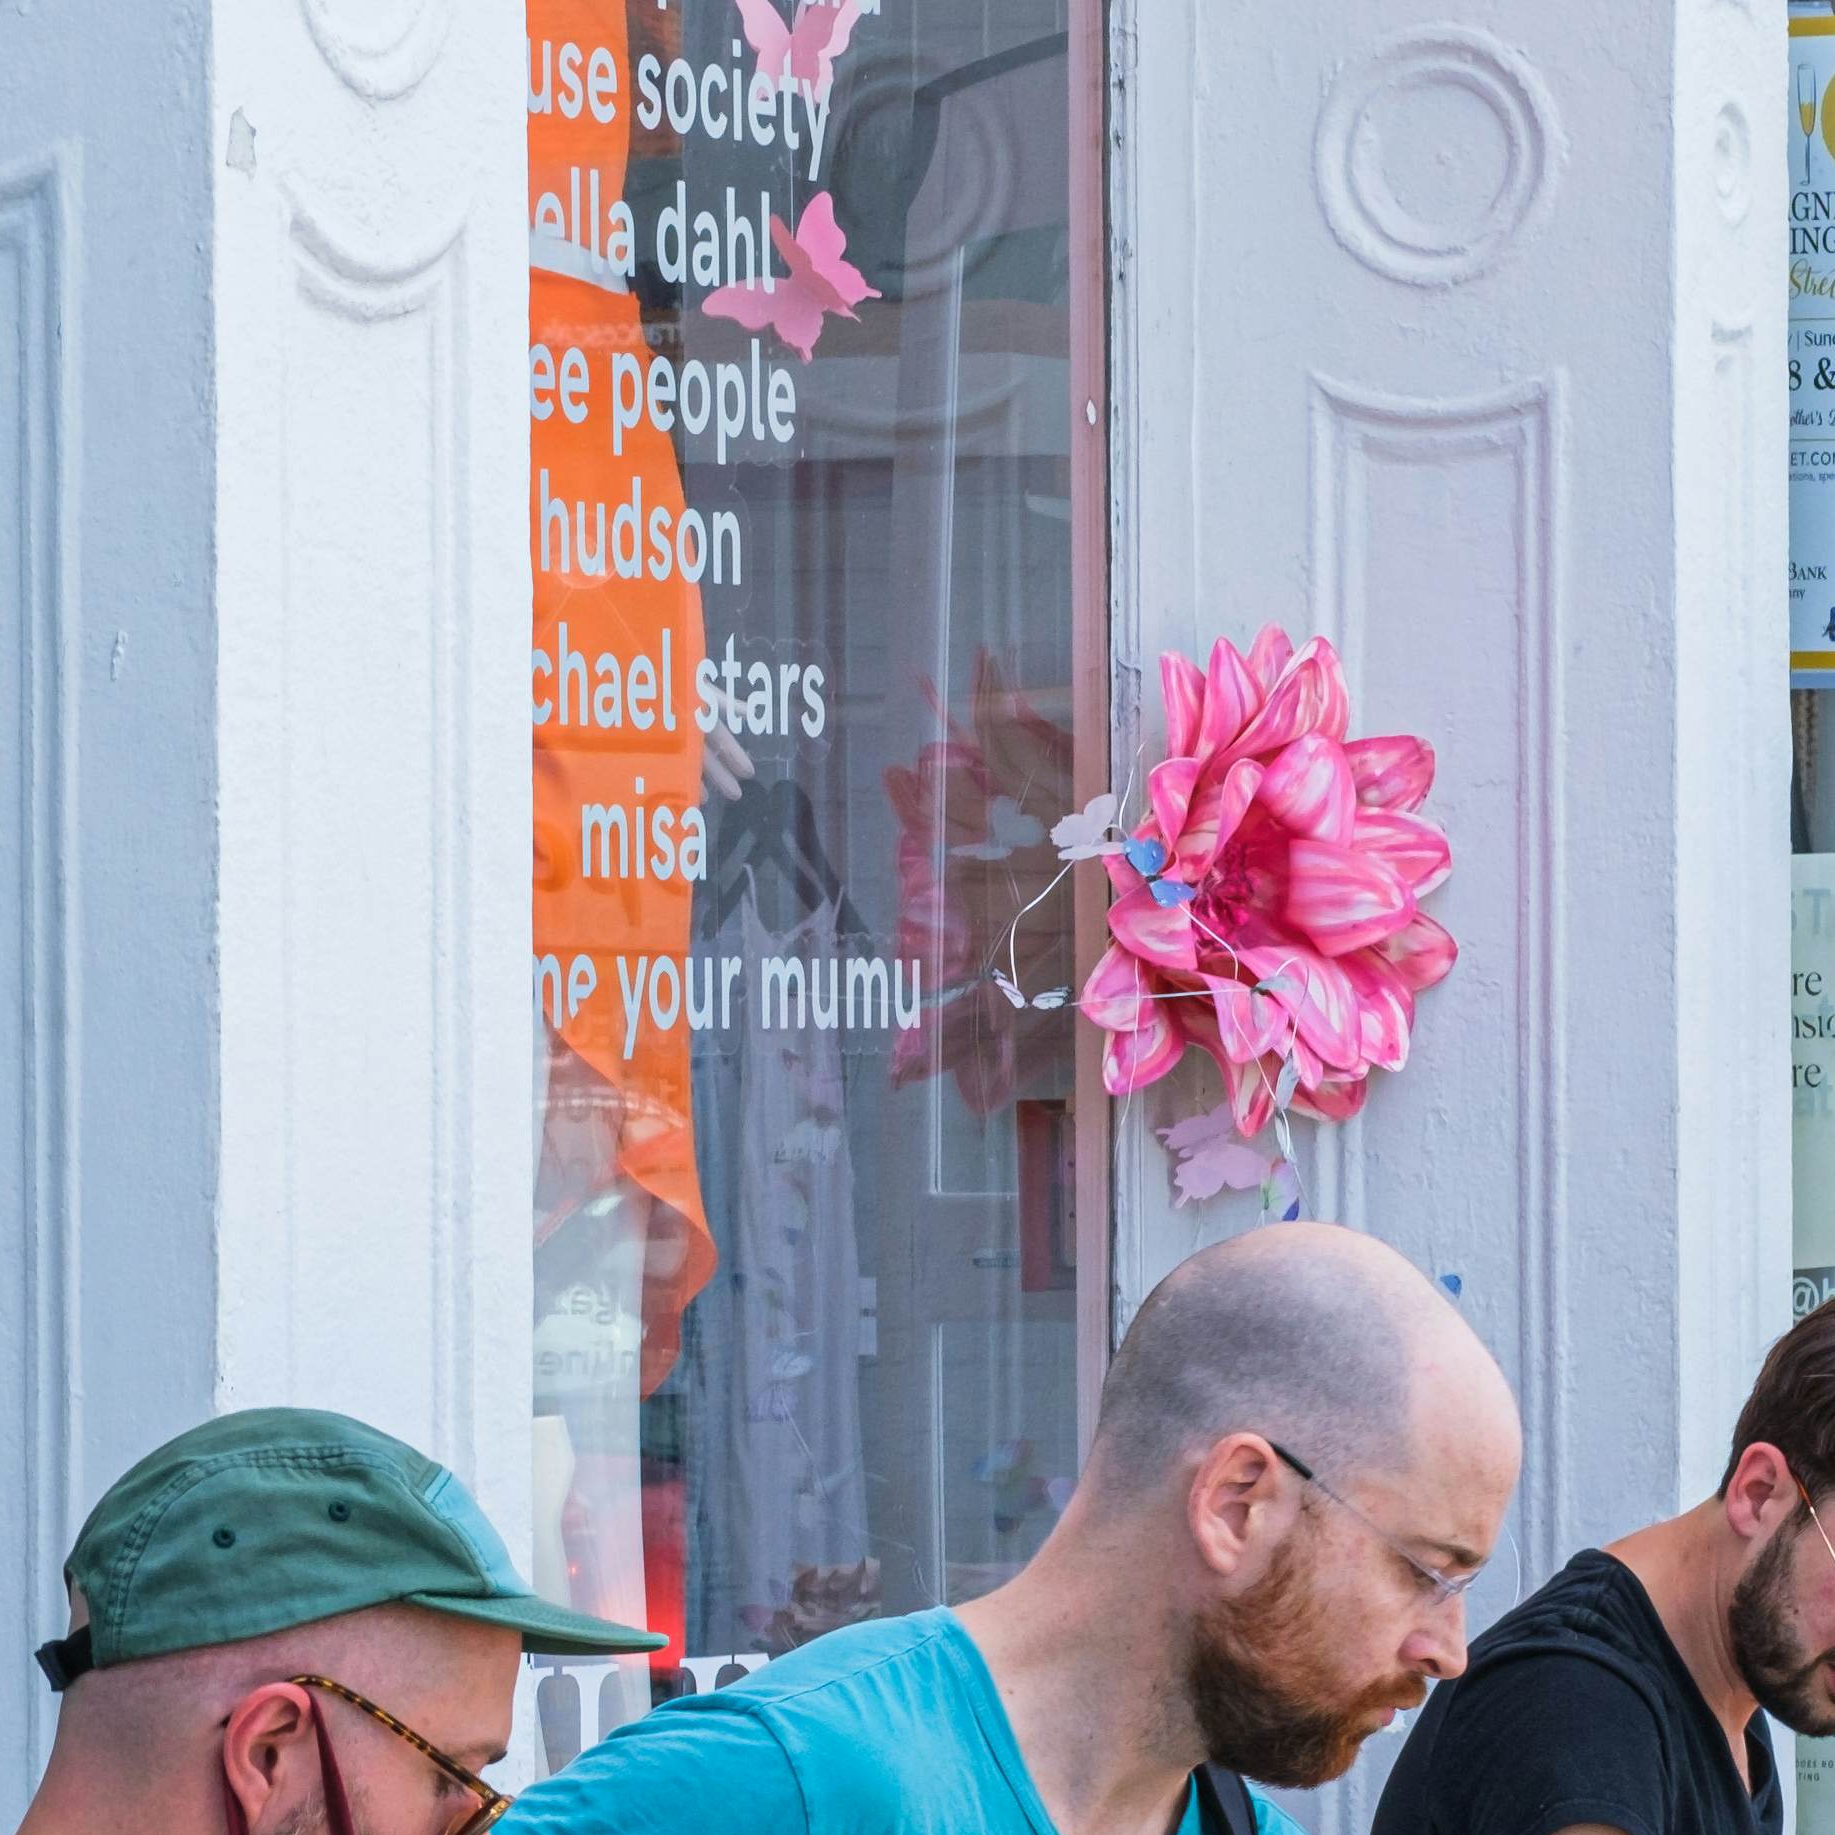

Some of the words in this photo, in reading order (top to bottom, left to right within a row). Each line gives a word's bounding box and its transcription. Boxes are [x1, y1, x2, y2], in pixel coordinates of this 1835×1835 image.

[637, 40, 832, 181] society
[656, 180, 775, 293] dahl
[612, 339, 796, 465] people
[540, 472, 742, 585] hudson
[533, 622, 675, 731] chael
[695, 633, 826, 738] stars
[581, 777, 707, 881] misa
[616, 954, 742, 1060] your
[761, 954, 921, 1030] mumu
